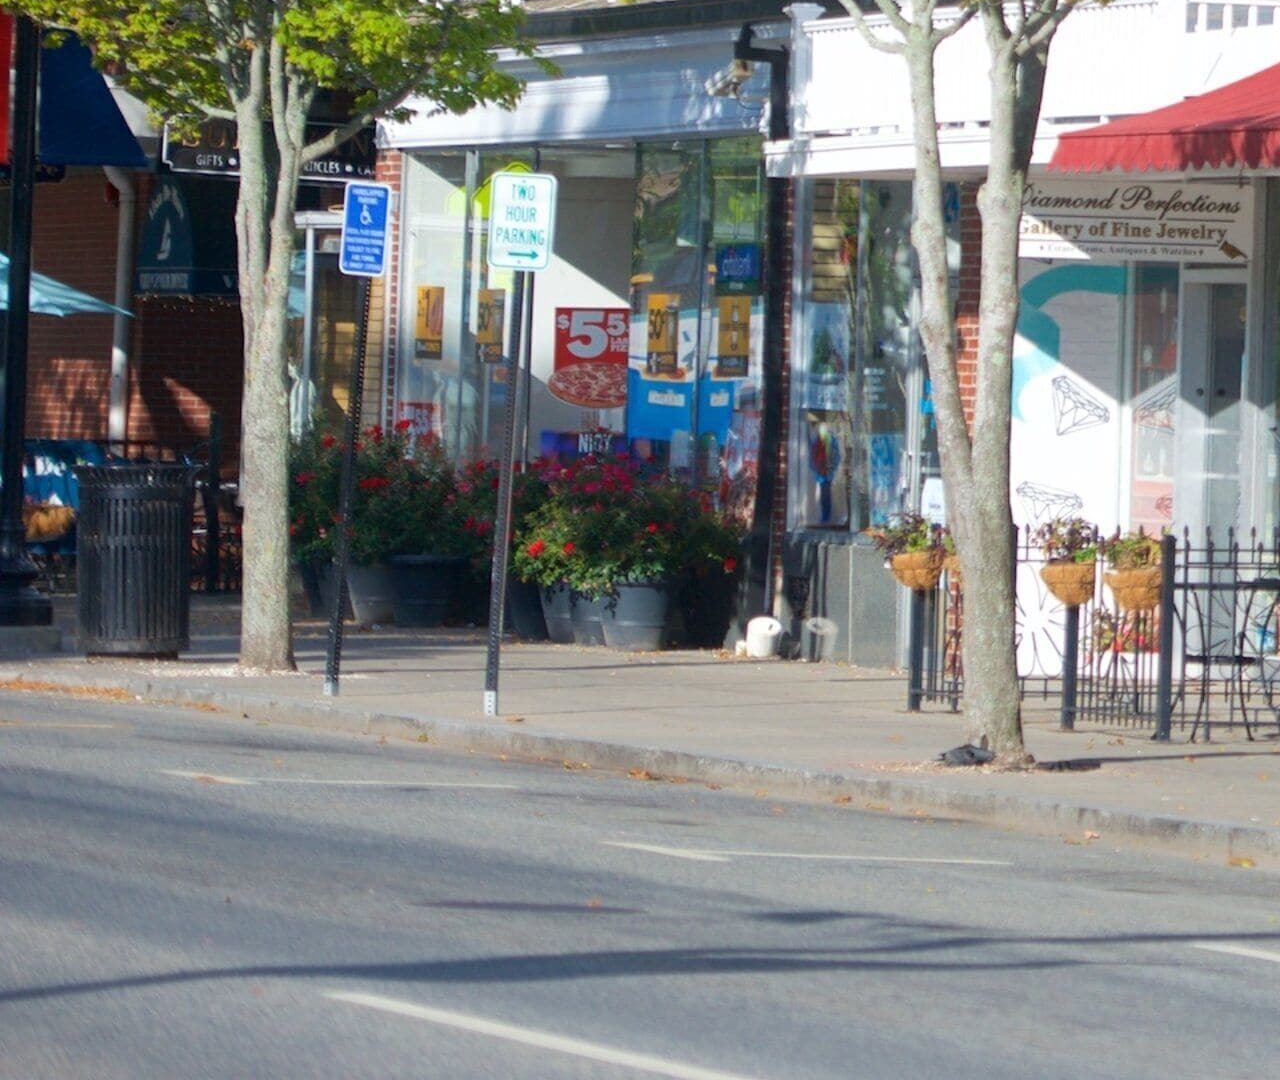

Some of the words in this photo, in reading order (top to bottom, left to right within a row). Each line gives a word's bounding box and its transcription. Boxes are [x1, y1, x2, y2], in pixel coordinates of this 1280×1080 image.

[195, 154, 223, 166] GIFTS
[512, 184, 536, 201] TWO
[1021, 183, 1119, 210] Diamond
[1121, 185, 1241, 221] Perfections
[506, 206, 537, 222] HOUR
[495, 227, 545, 246] PARKING
[1089, 222, 1106, 236] of
[1111, 223, 1151, 238] Fine
[1156, 223, 1227, 244] Jewelry
